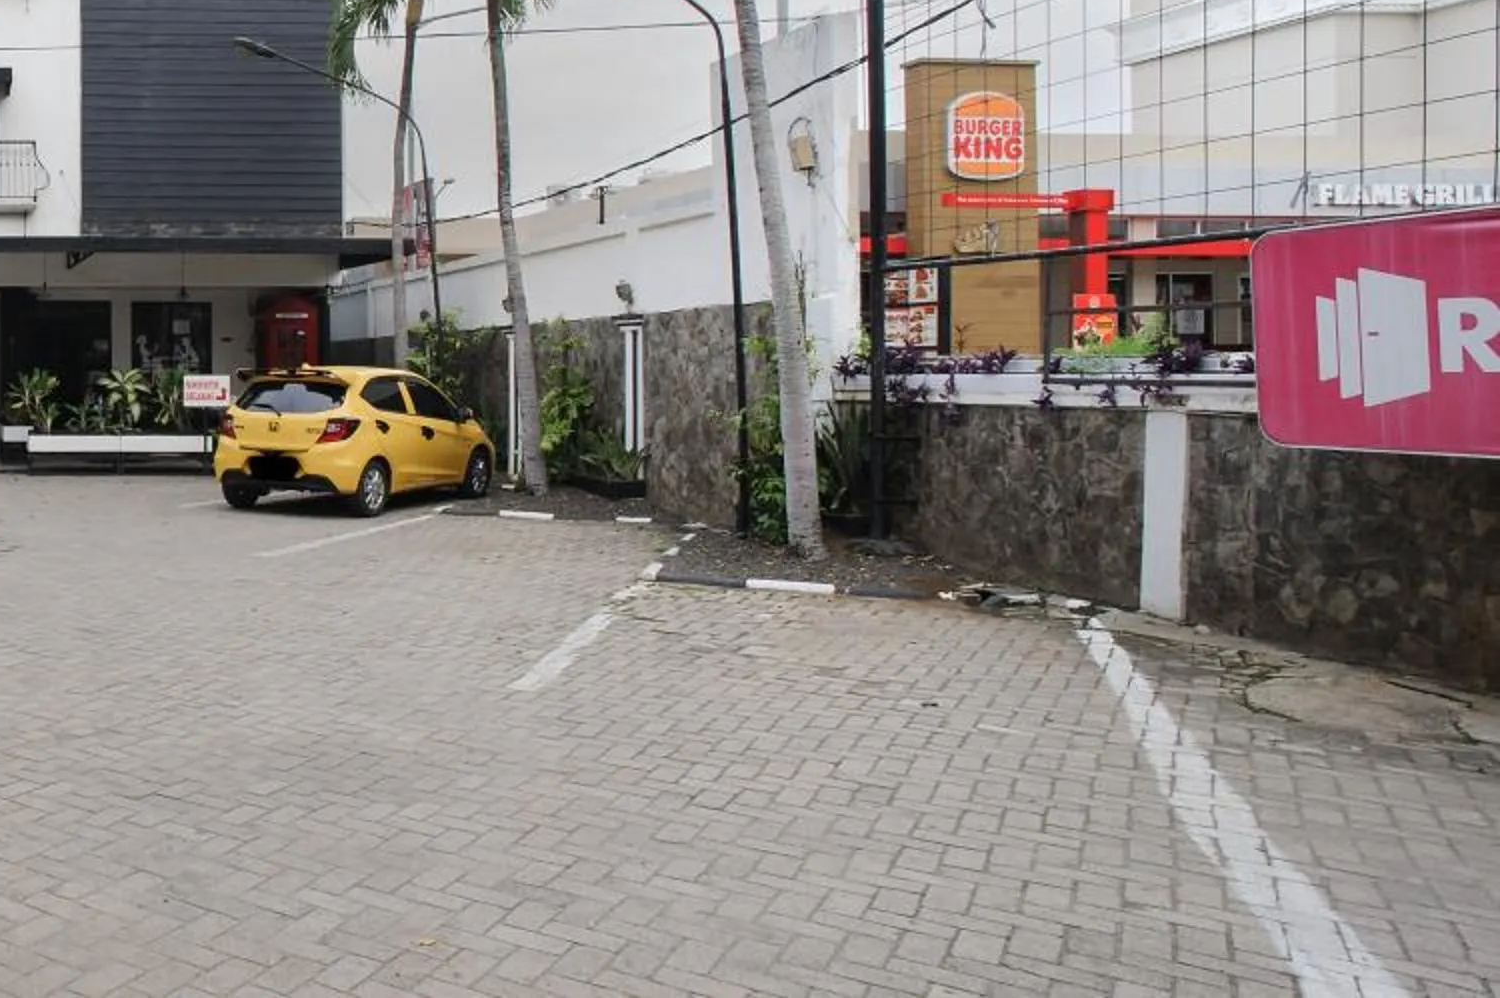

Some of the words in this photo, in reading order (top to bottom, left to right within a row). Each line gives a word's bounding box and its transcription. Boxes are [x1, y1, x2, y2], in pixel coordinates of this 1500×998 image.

[954, 118, 1023, 137] BURGER
[954, 136, 1023, 160] KING
[1318, 183, 1412, 205] FLAME
